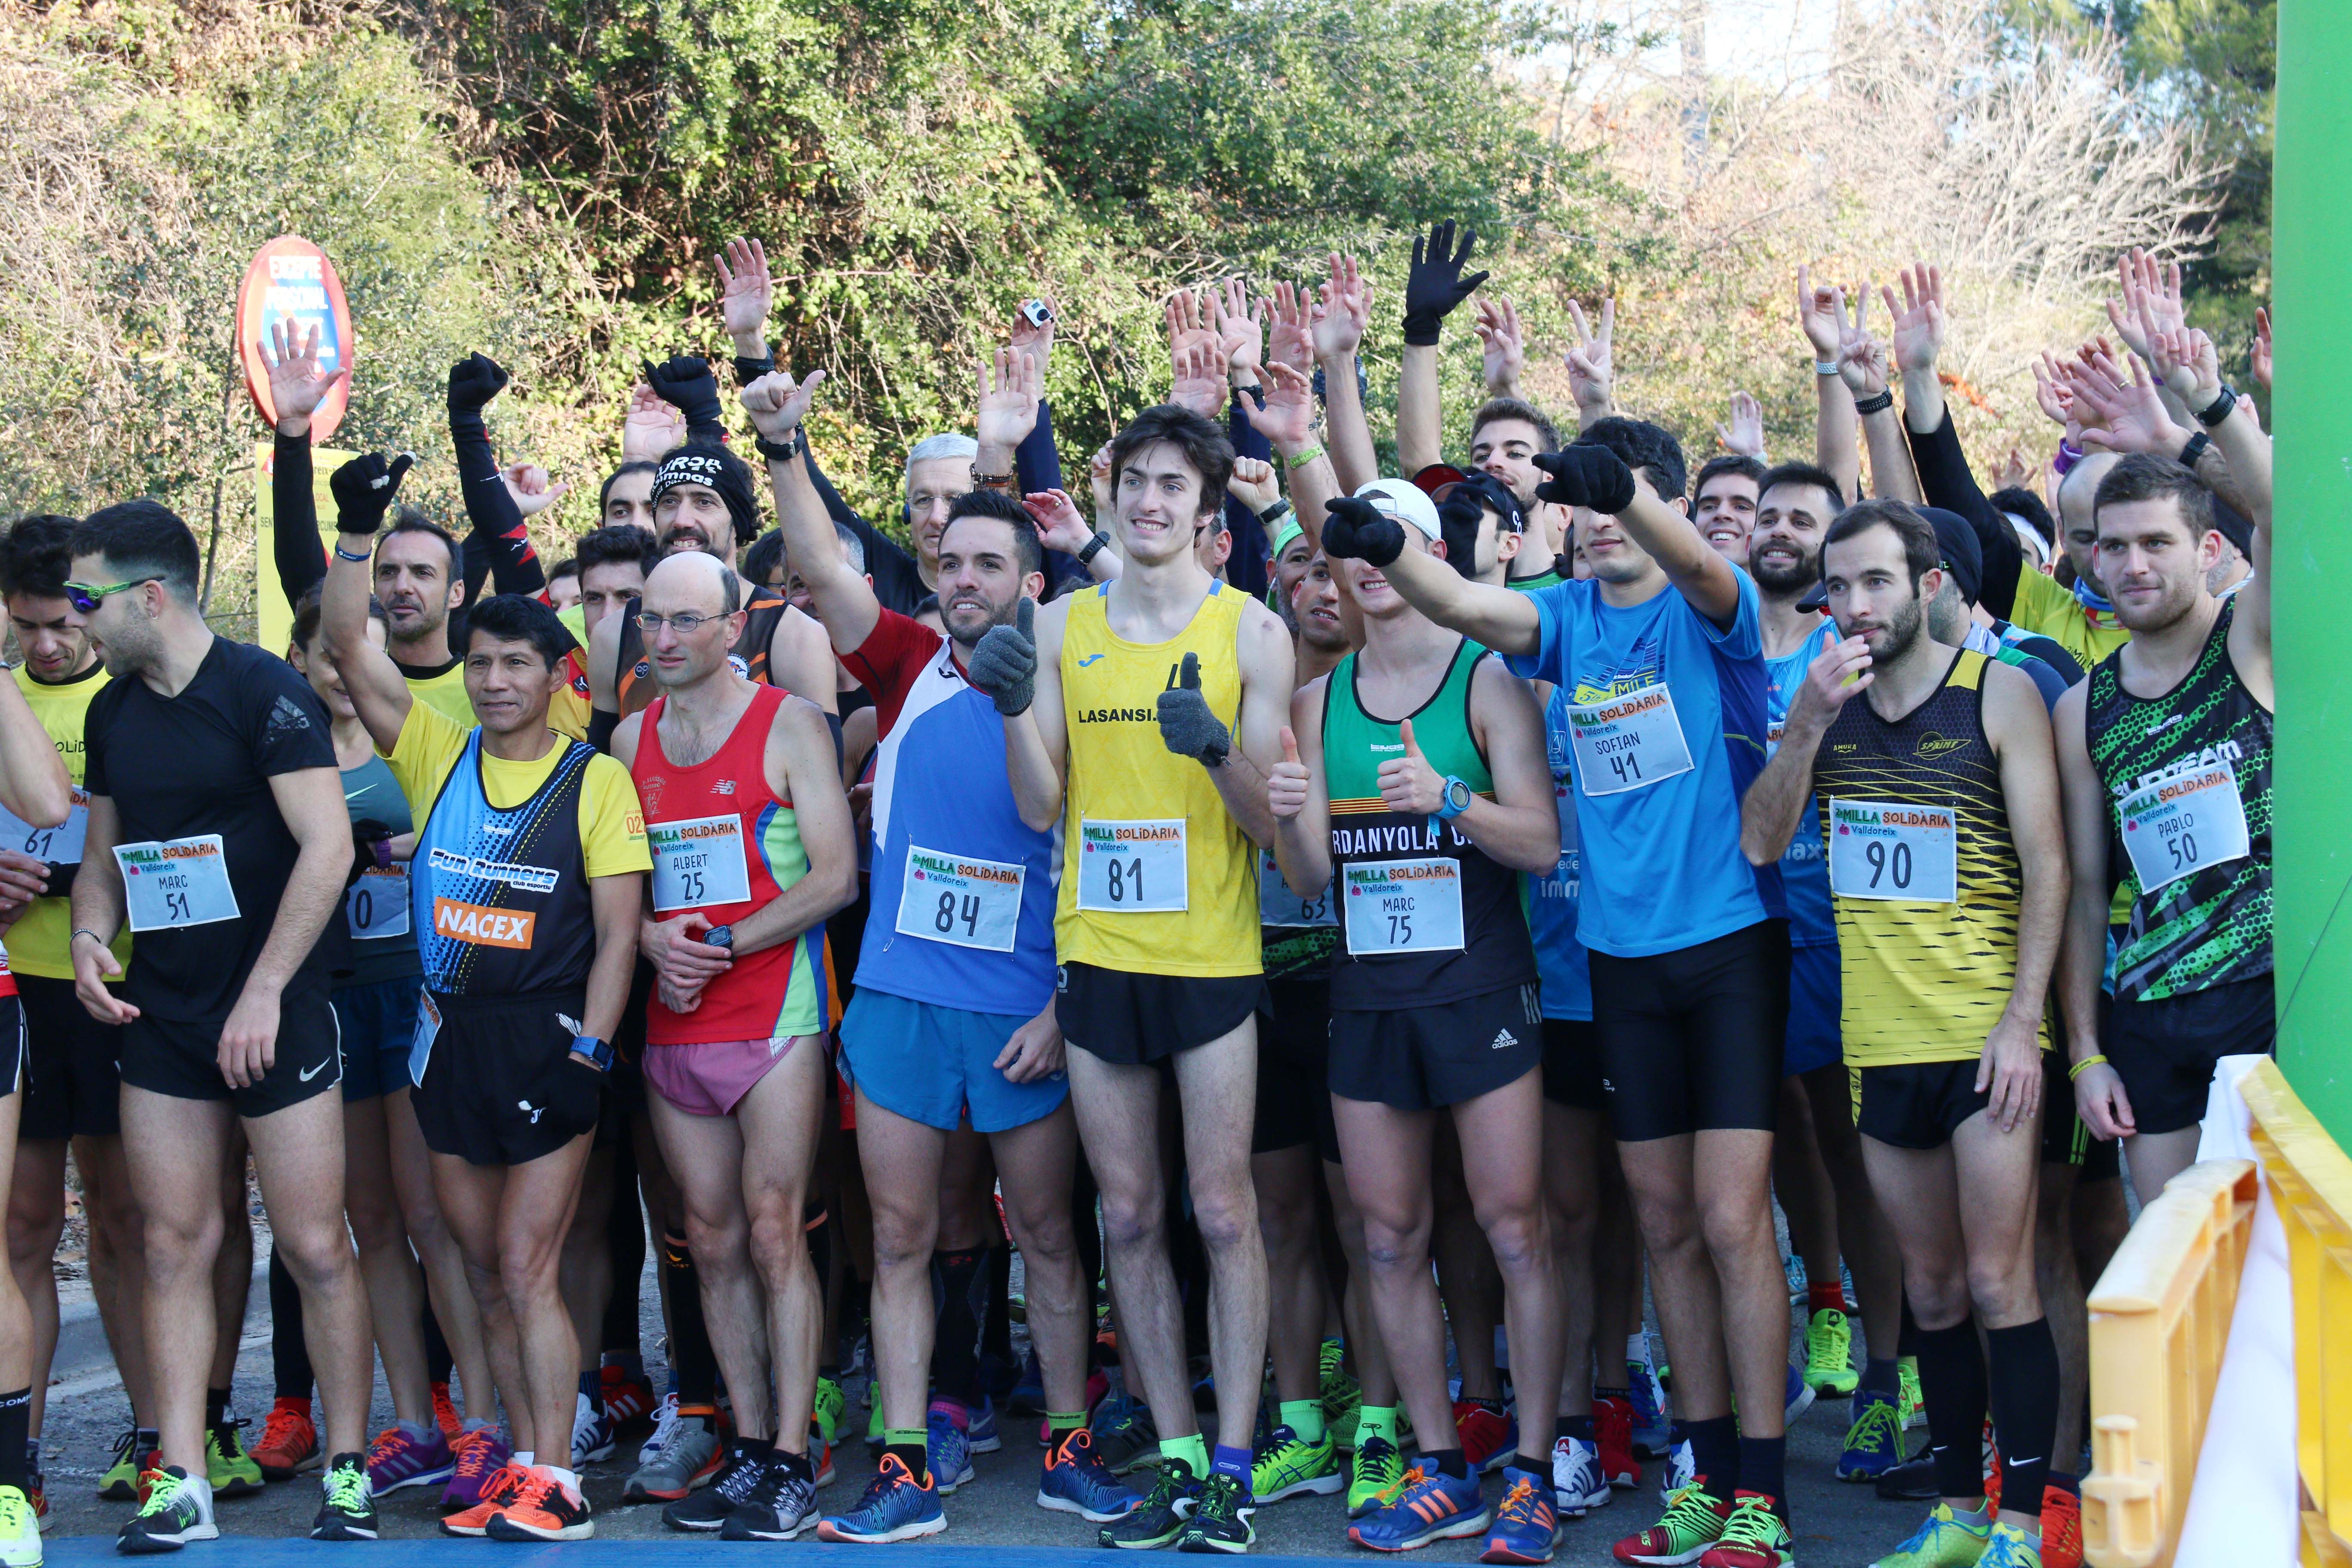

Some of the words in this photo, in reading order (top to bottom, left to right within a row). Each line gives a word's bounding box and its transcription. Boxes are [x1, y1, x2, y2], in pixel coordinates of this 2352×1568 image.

[1574, 713, 1598, 725] MILLA
[1583, 724, 1617, 736] Valldoreix
[1595, 732, 1641, 754] SOFIAN
[1920, 741, 1959, 750] SPRINT
[1610, 752, 1642, 782] 41
[2127, 794, 2158, 815] MILLA
[1843, 809, 1879, 823] MILLA
[2137, 804, 2176, 824] Valldoreix
[1089, 828, 1114, 839] MILLA
[1839, 824, 1849, 833] de
[1852, 825, 1896, 836] Valldoreix
[2158, 813, 2194, 838] PABLO
[24, 829, 53, 857] 61
[653, 830, 679, 842] MILLA
[1332, 826, 1439, 854] RDANYOLA
[130, 849, 160, 860] MILLA
[660, 842, 694, 852] Valldoreix
[1096, 842, 1128, 851] Valldoreix
[2167, 833, 2197, 870] 50
[140, 862, 176, 872] Valldoreix
[674, 854, 708, 870] ALBERT
[920, 857, 954, 873] MILLA
[1866, 841, 1912, 888] 90
[159, 875, 188, 889] MARC
[915, 869, 924, 878] de
[928, 872, 968, 887] Valldoreix
[1109, 858, 1143, 902] 81
[1354, 870, 1387, 881] MILLA
[527, 882, 551, 890] esportiu
[681, 871, 704, 900] 25
[1363, 883, 1403, 893] Valldoreix
[166, 892, 190, 920] 51
[355, 889, 372, 929] 0
[1302, 893, 1326, 920] 63
[1384, 897, 1415, 912] MARC
[935, 891, 980, 937] 84
[438, 905, 529, 942] NACEX
[1388, 915, 1412, 944] 75
[1492, 1038, 1518, 1049] adidas
